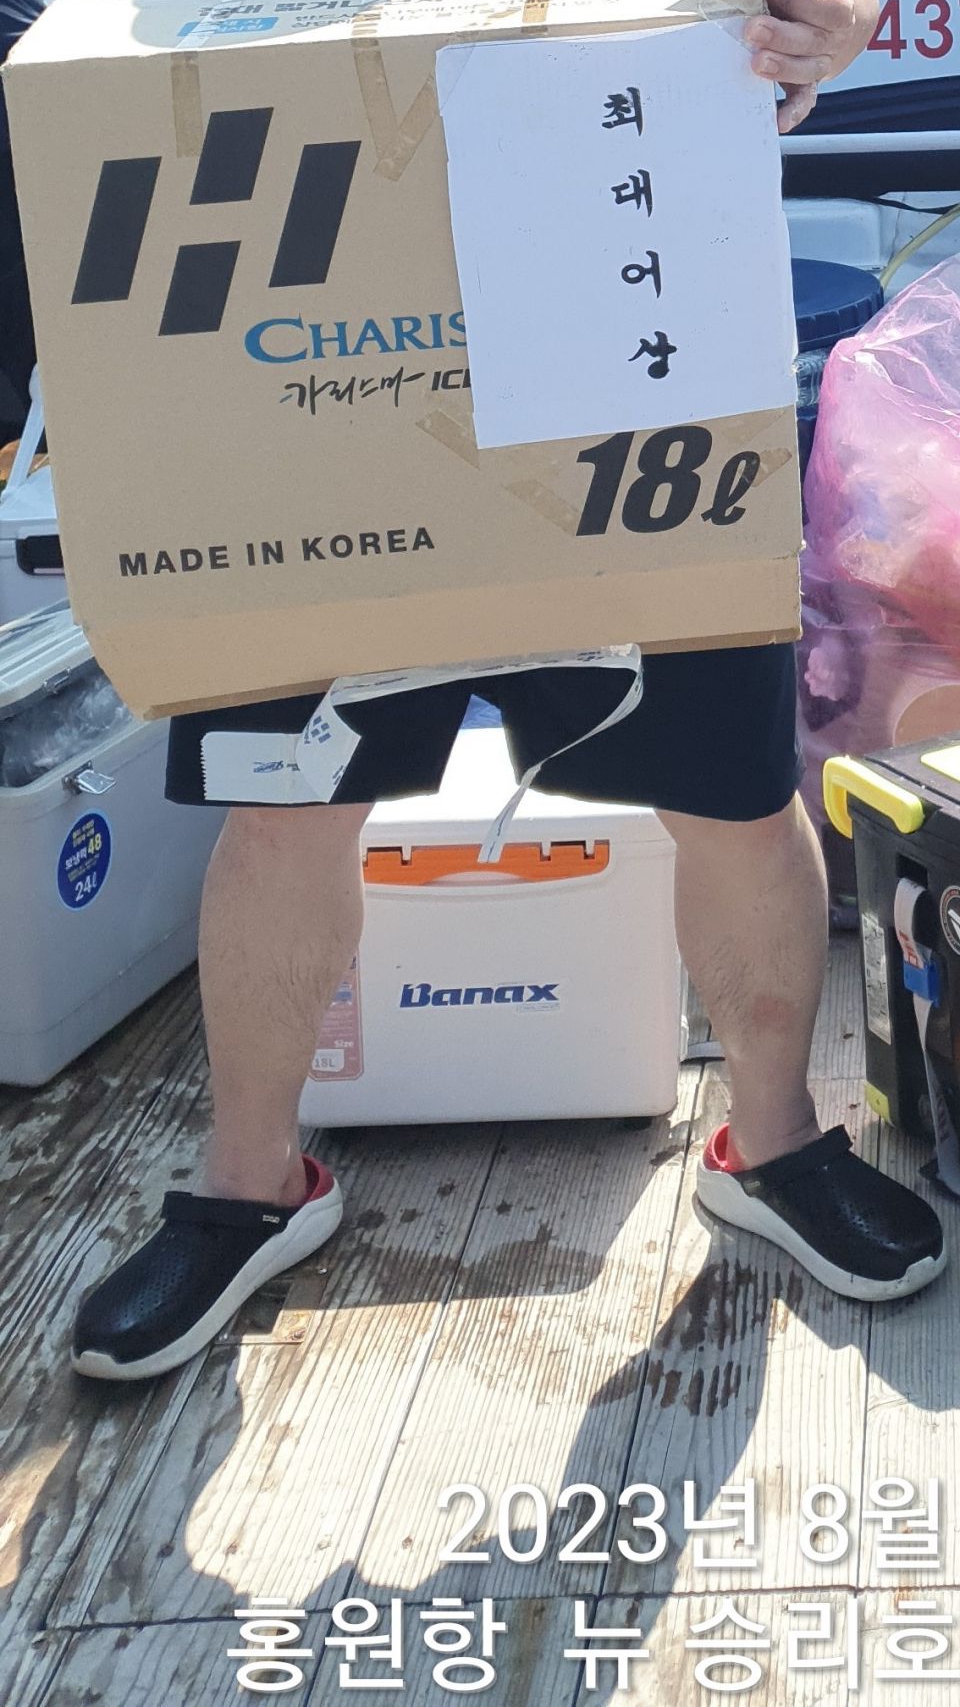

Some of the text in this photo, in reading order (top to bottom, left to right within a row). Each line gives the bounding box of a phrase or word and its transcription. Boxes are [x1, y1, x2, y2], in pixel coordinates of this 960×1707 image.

[431, 368, 471, 392] IC
[119, 526, 436, 577] MADE IN KOREA
[400, 981, 560, 1009] Banax
